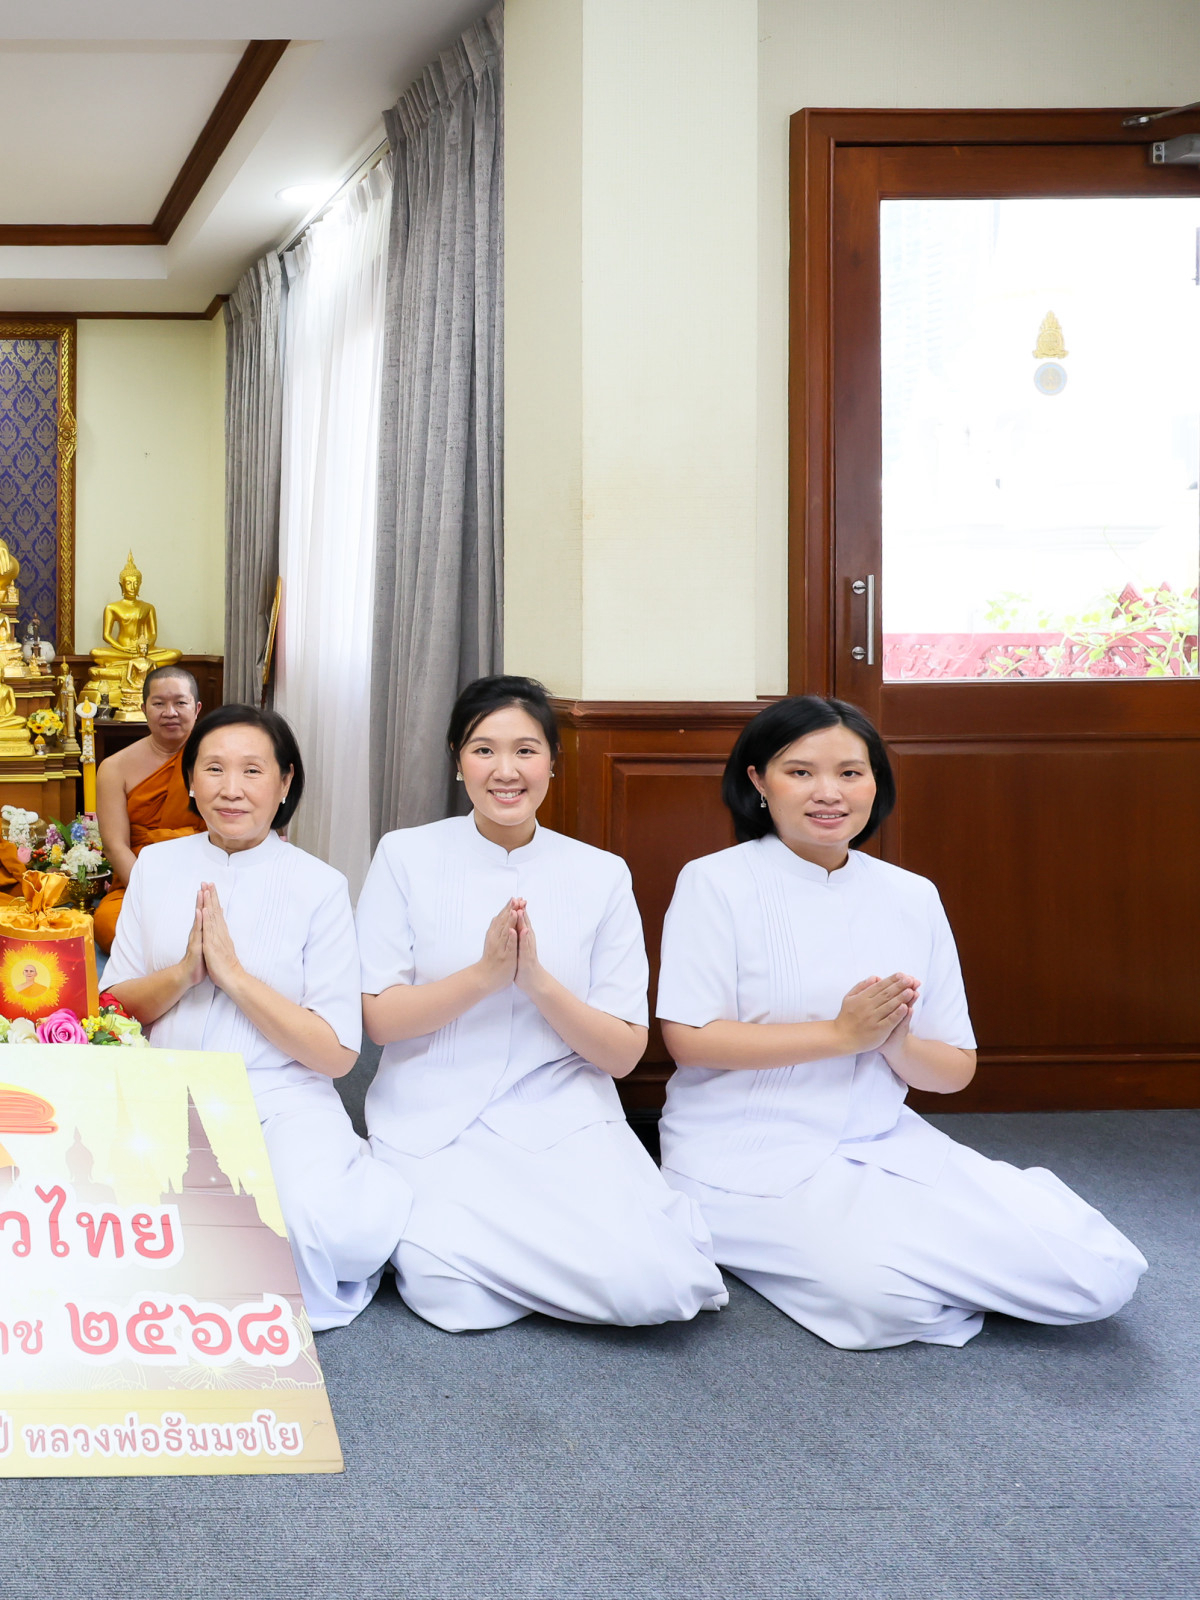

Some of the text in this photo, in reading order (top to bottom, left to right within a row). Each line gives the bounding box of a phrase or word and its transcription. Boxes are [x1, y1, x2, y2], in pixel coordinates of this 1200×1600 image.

[65, 1300, 290, 1356] ๒๕๖๘
[24, 1418, 300, 1455] หลวงพ่อธัมมชโย
